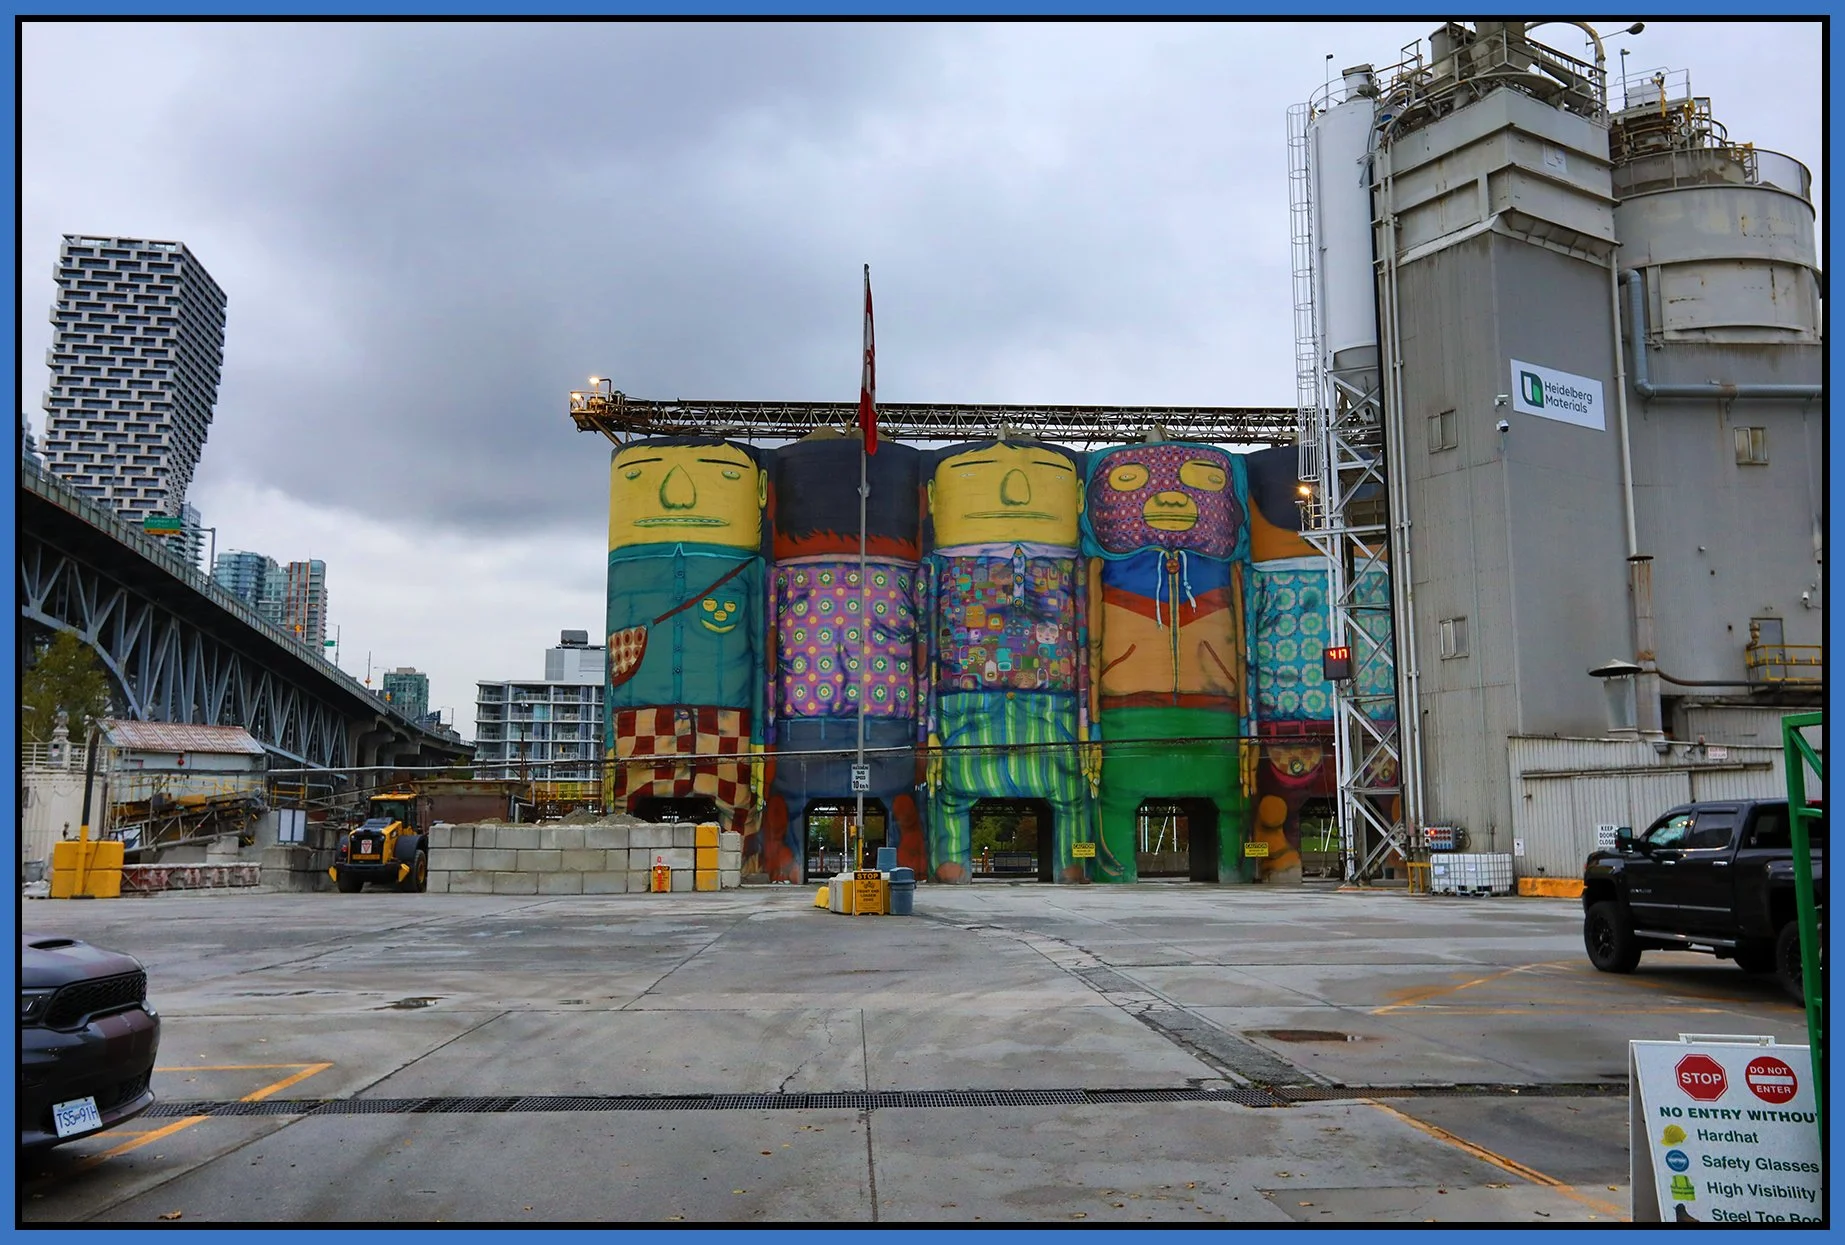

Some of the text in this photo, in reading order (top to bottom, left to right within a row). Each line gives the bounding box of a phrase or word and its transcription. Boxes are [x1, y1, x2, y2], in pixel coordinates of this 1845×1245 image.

[1544, 381, 1593, 405] Heidelberg
[1545, 395, 1588, 414] Materials
[852, 780, 859, 789] 10
[1750, 1066, 1788, 1075] DO NOT
[1681, 1072, 1722, 1085] STOP
[1756, 1085, 1792, 1094] ENTER
[1660, 1106, 1818, 1123] NO ENTRY WITHOU
[1697, 1129, 1759, 1144] Hardhat
[1702, 1155, 1820, 1173] Safety Glasses
[1706, 1181, 1816, 1203] High Visibility
[1711, 1208, 1751, 1222] Steel
[1755, 1211, 1785, 1222] Toe
